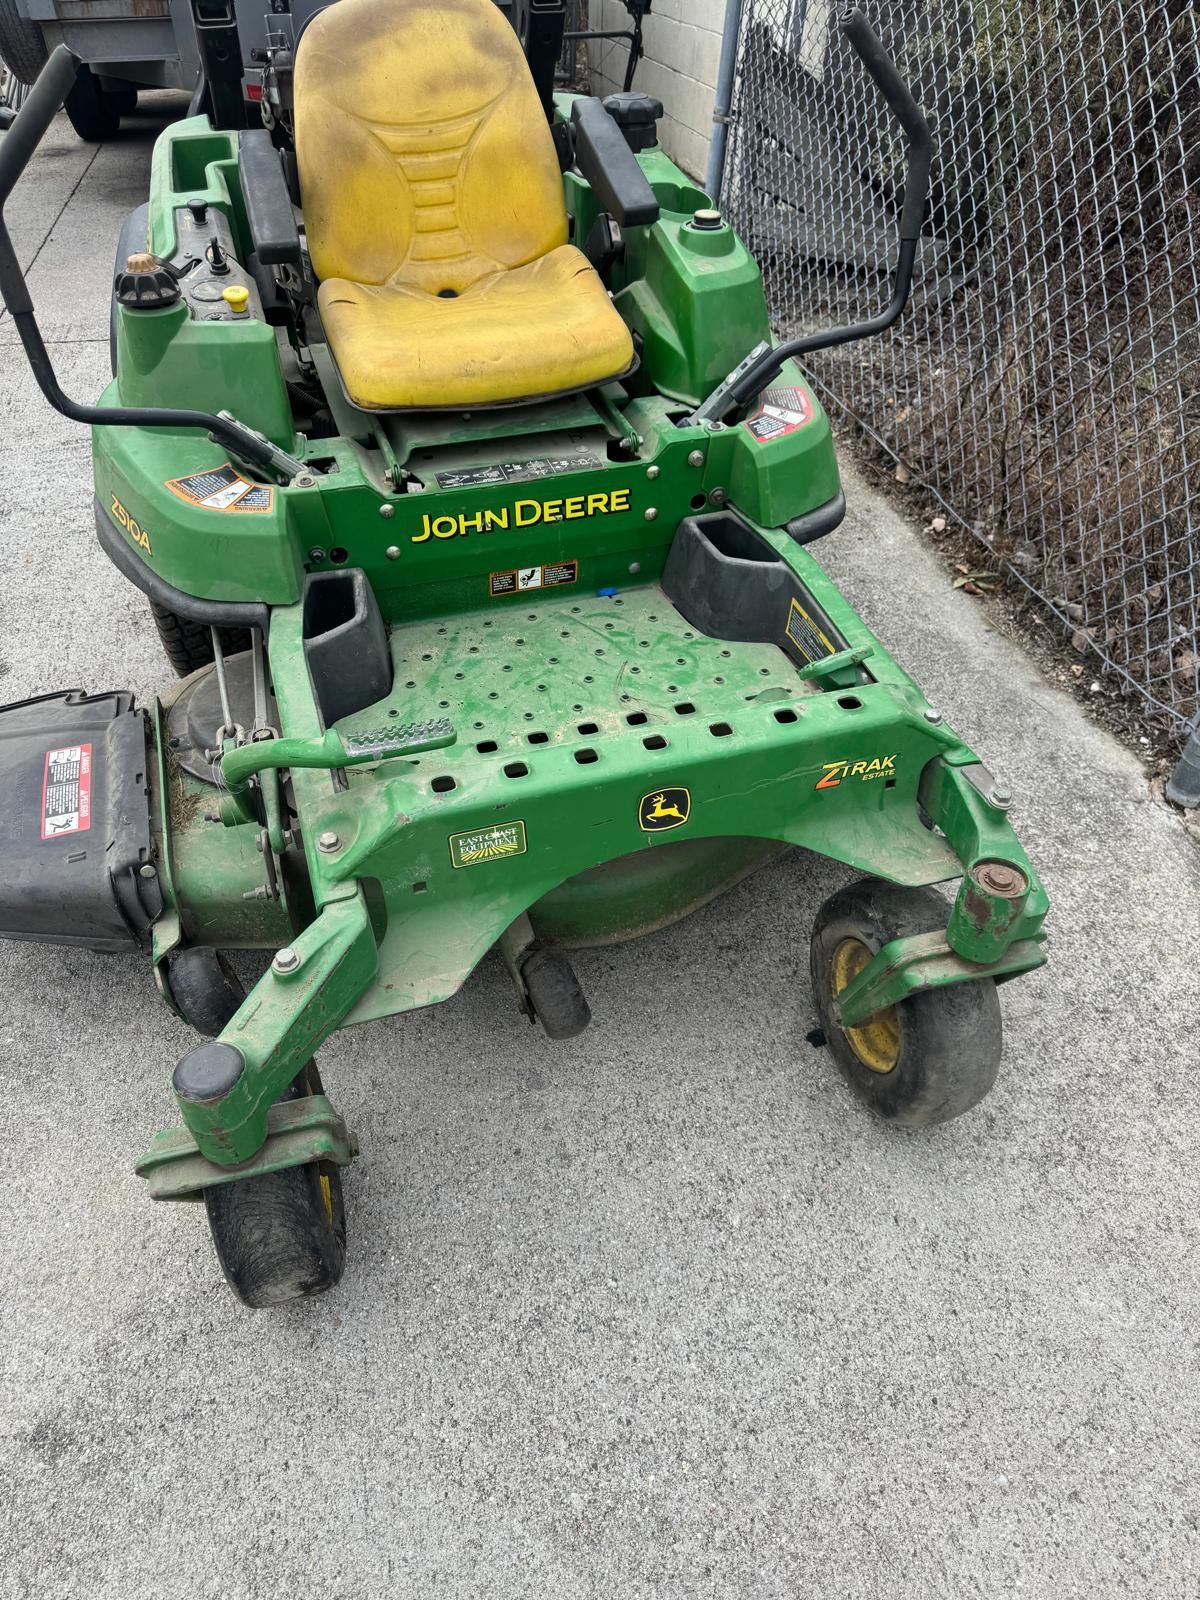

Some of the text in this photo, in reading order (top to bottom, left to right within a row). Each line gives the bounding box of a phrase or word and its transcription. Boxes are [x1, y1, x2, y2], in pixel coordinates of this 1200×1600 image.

[111, 493, 152, 556] Z510A
[411, 488, 631, 543] JOHN DEERE
[862, 768, 896, 781] ESTATE
[459, 834, 485, 847] EAST
[460, 835, 517, 854] EQUIPMENT
